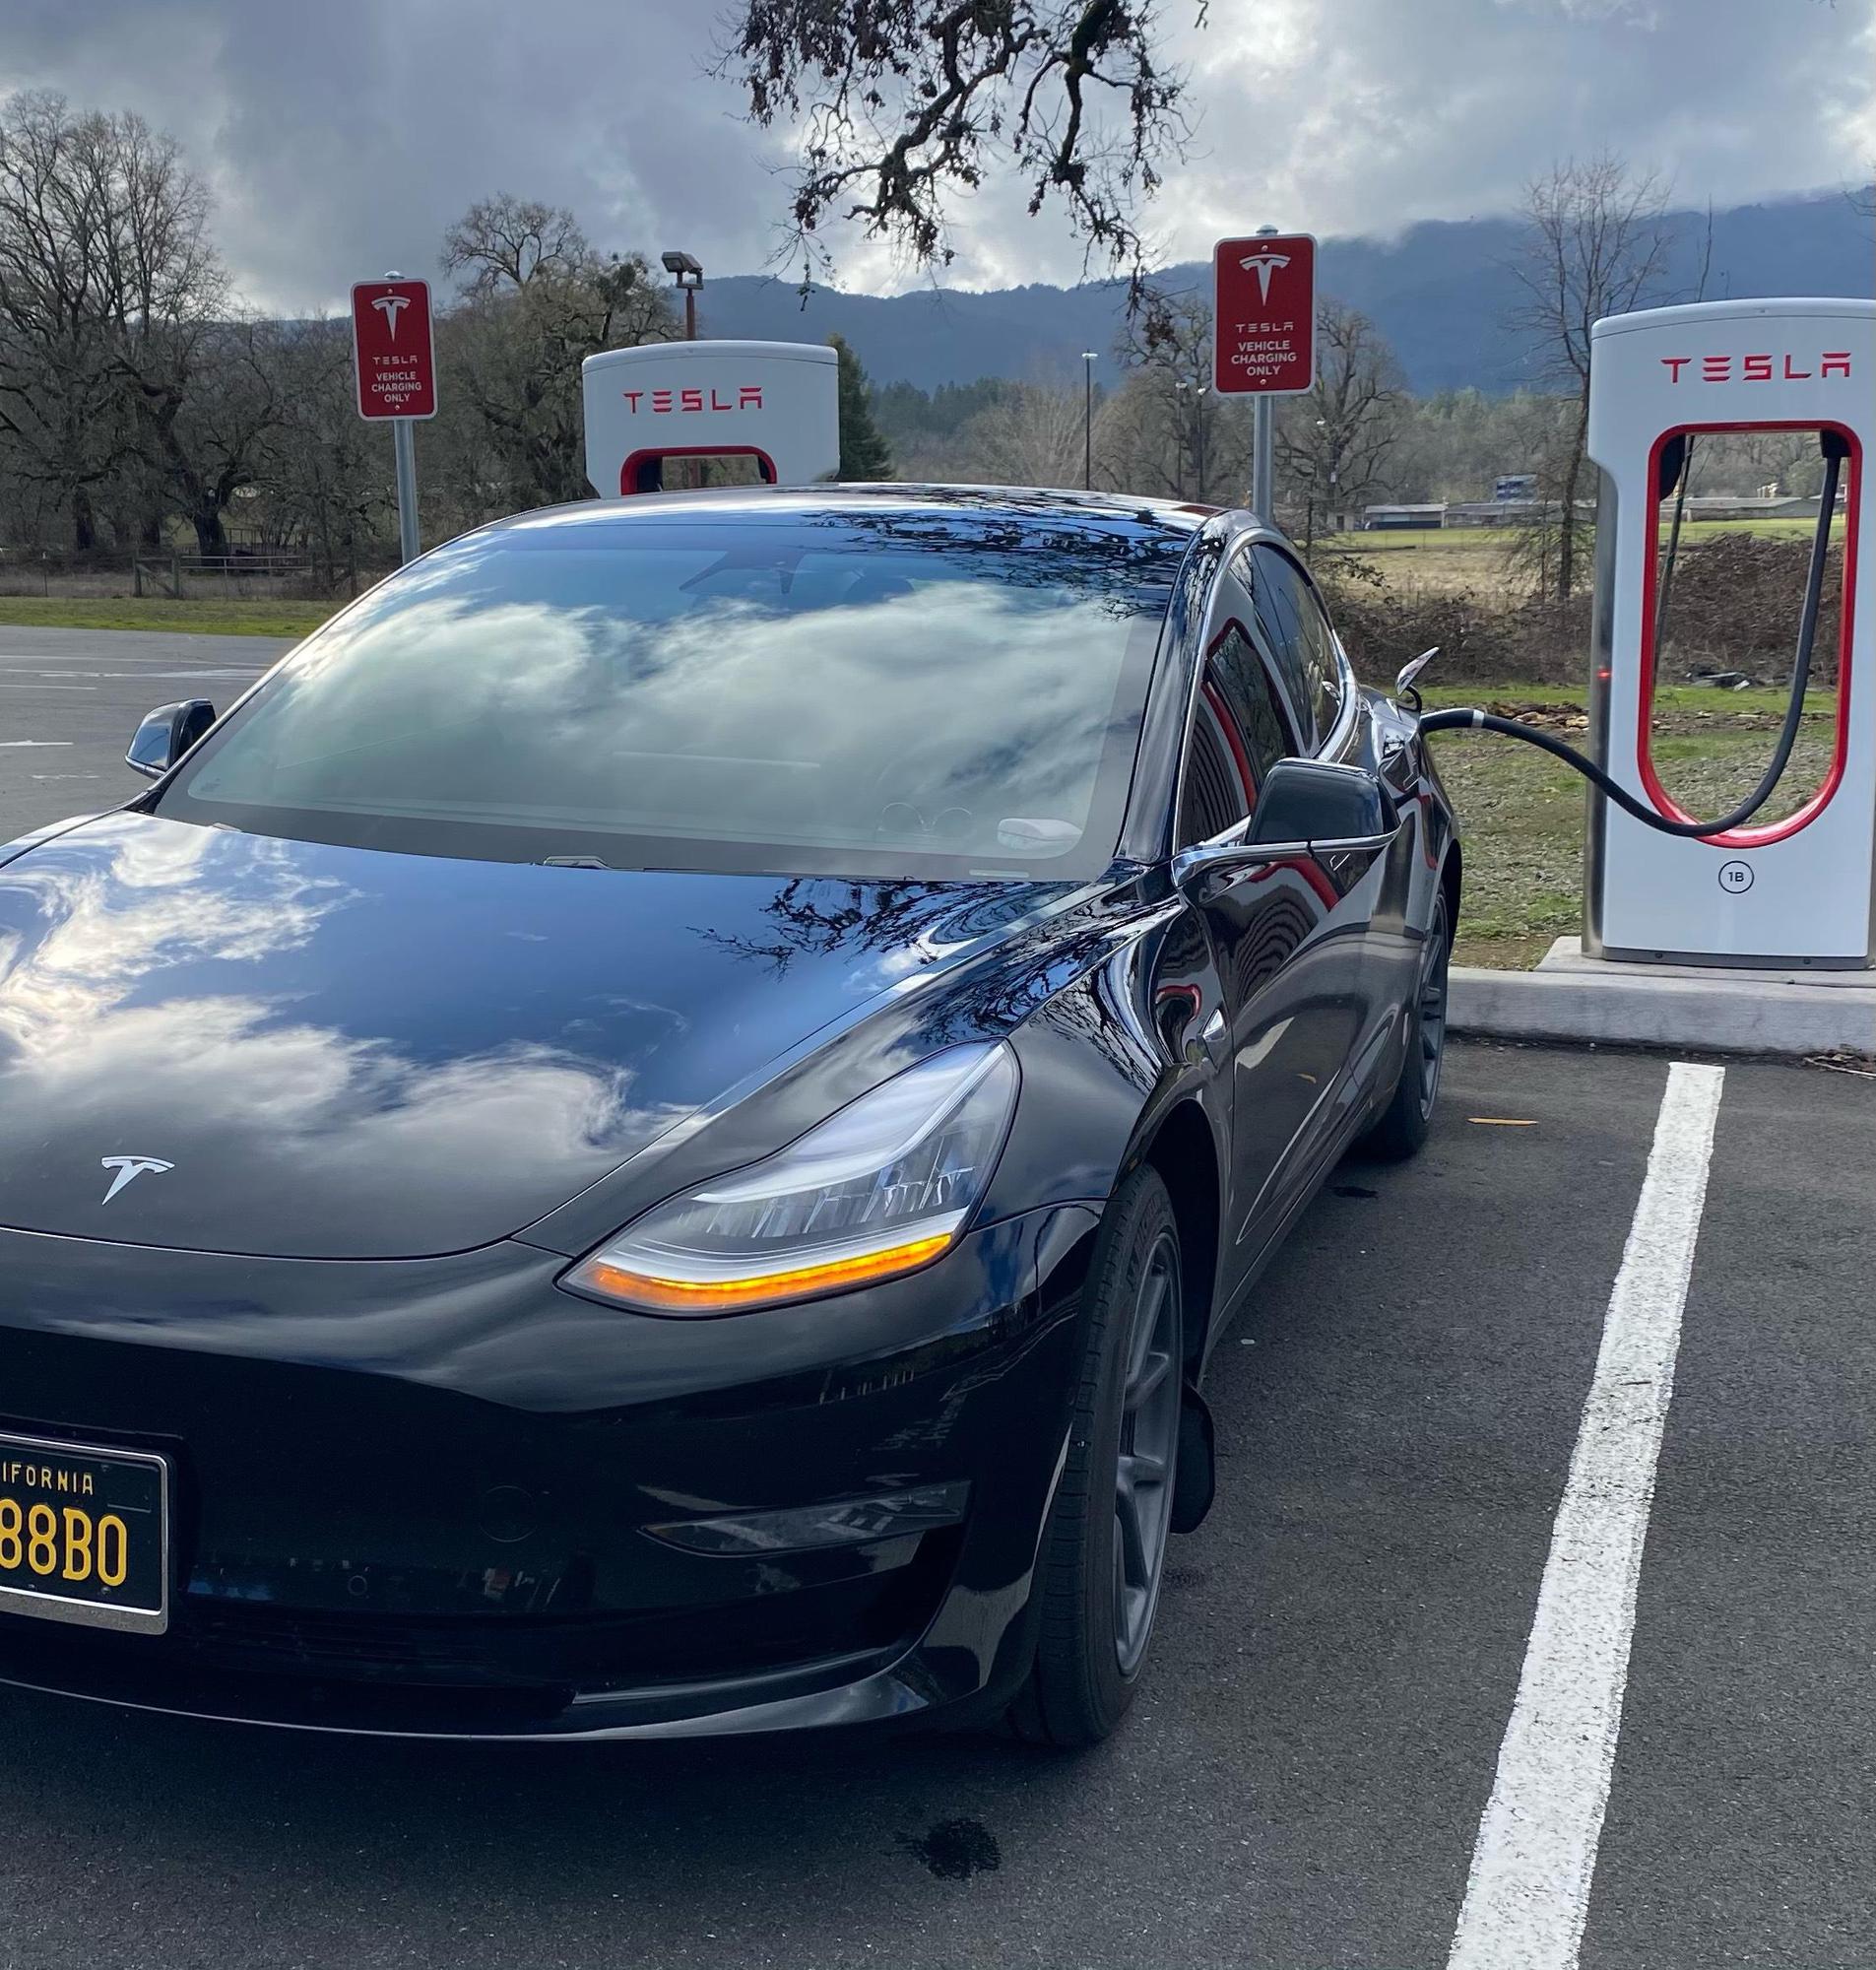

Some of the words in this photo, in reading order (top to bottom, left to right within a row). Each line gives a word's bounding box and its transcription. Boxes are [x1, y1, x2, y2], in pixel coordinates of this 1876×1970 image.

[1236, 321, 1294, 333] TESLA
[1238, 340, 1290, 352] VEHICLE
[372, 355, 418, 364] TESLA
[1231, 352, 1297, 364] CHARGING
[1246, 365, 1281, 376] ONLY
[1660, 353, 1851, 383] TESLA
[376, 371, 417, 381] VEHICLE
[371, 381, 421, 392] CHARGING
[384, 393, 411, 403] ONLY
[622, 386, 763, 414] TESLA
[1728, 872, 1744, 882] 1B
